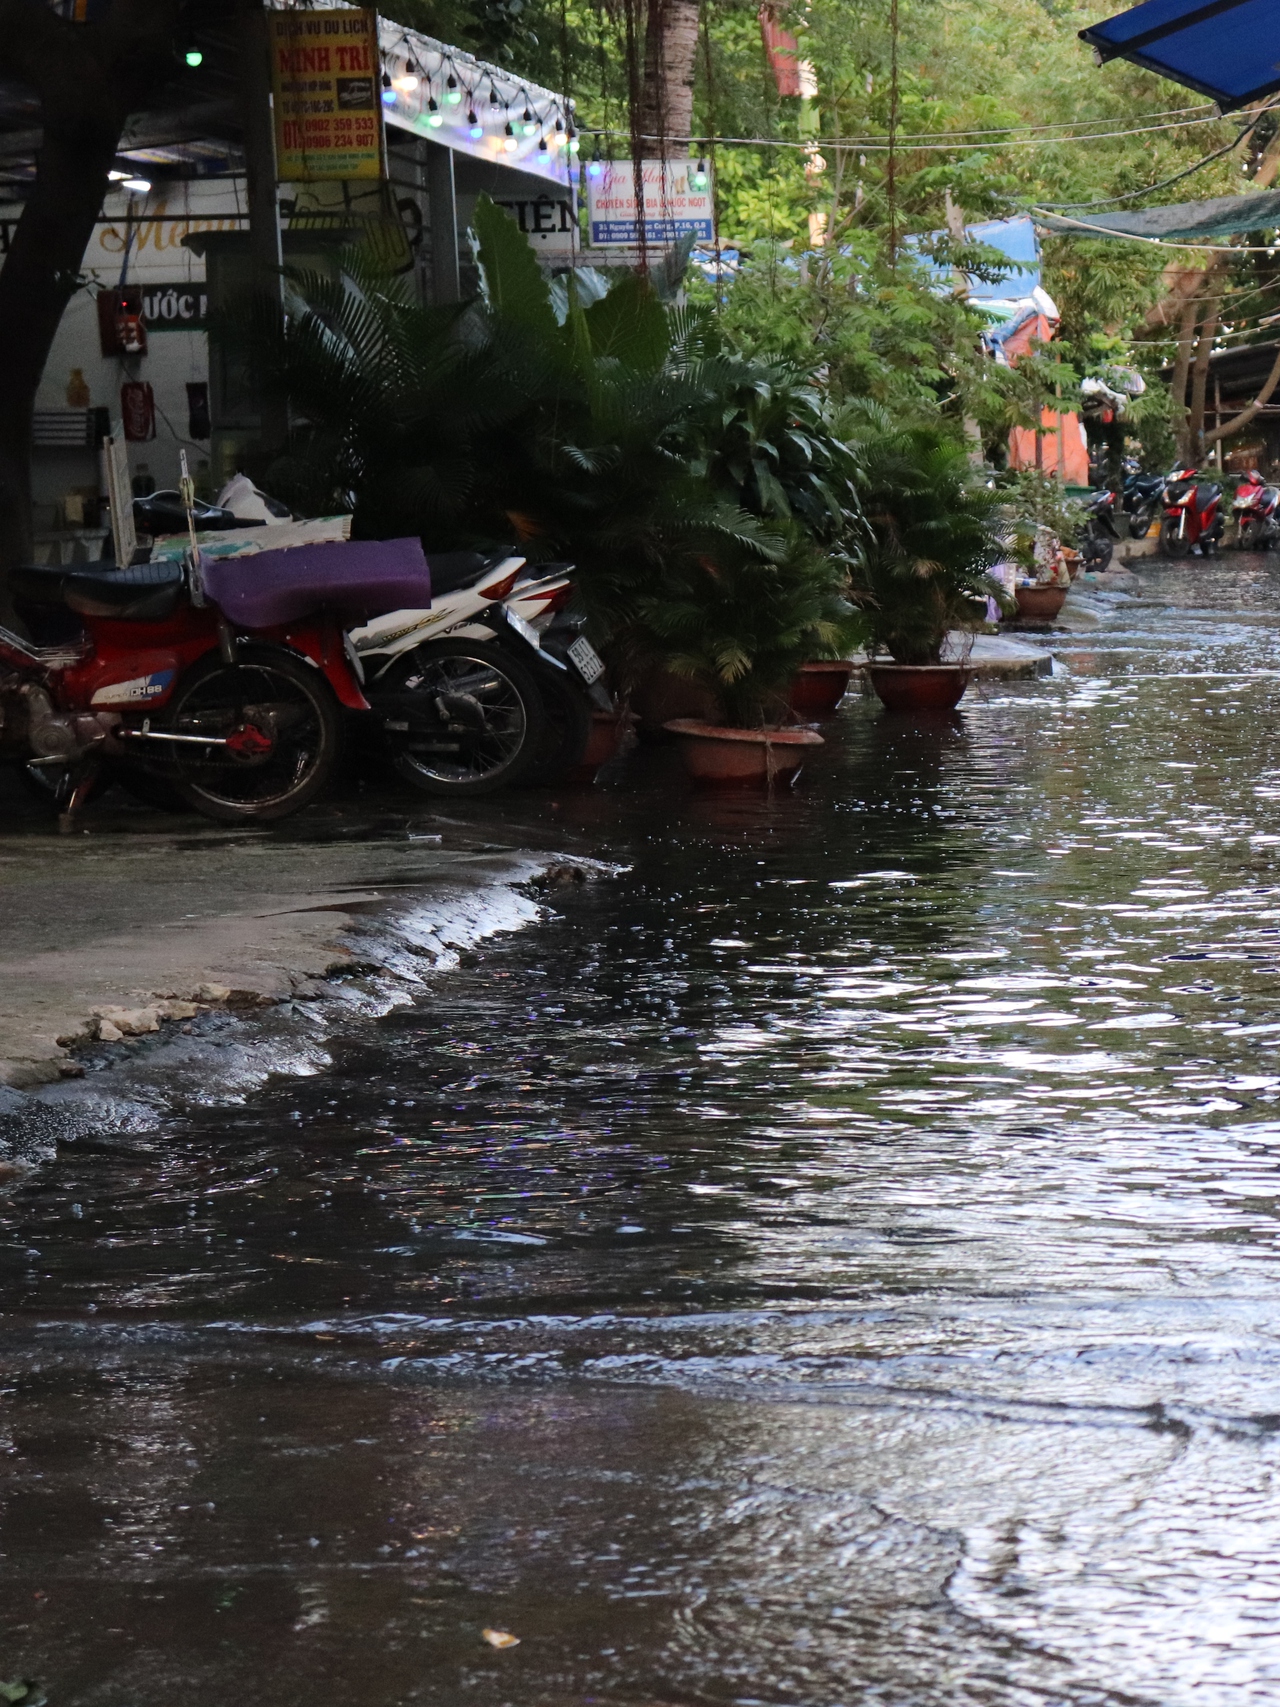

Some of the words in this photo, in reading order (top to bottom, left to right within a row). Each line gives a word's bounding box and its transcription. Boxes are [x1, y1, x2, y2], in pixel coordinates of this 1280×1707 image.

[306, 20, 320, 38] VỤ
[343, 18, 368, 37] LỊCH
[279, 46, 331, 73] MINH
[336, 38, 371, 71] TRÍ
[306, 119, 330, 131] 0902
[355, 117, 375, 130] 533
[494, 193, 578, 240] IỆN
[646, 198, 657, 208] BIA
[688, 197, 707, 210] NGỌT
[143, 288, 195, 320] ƯỚC
